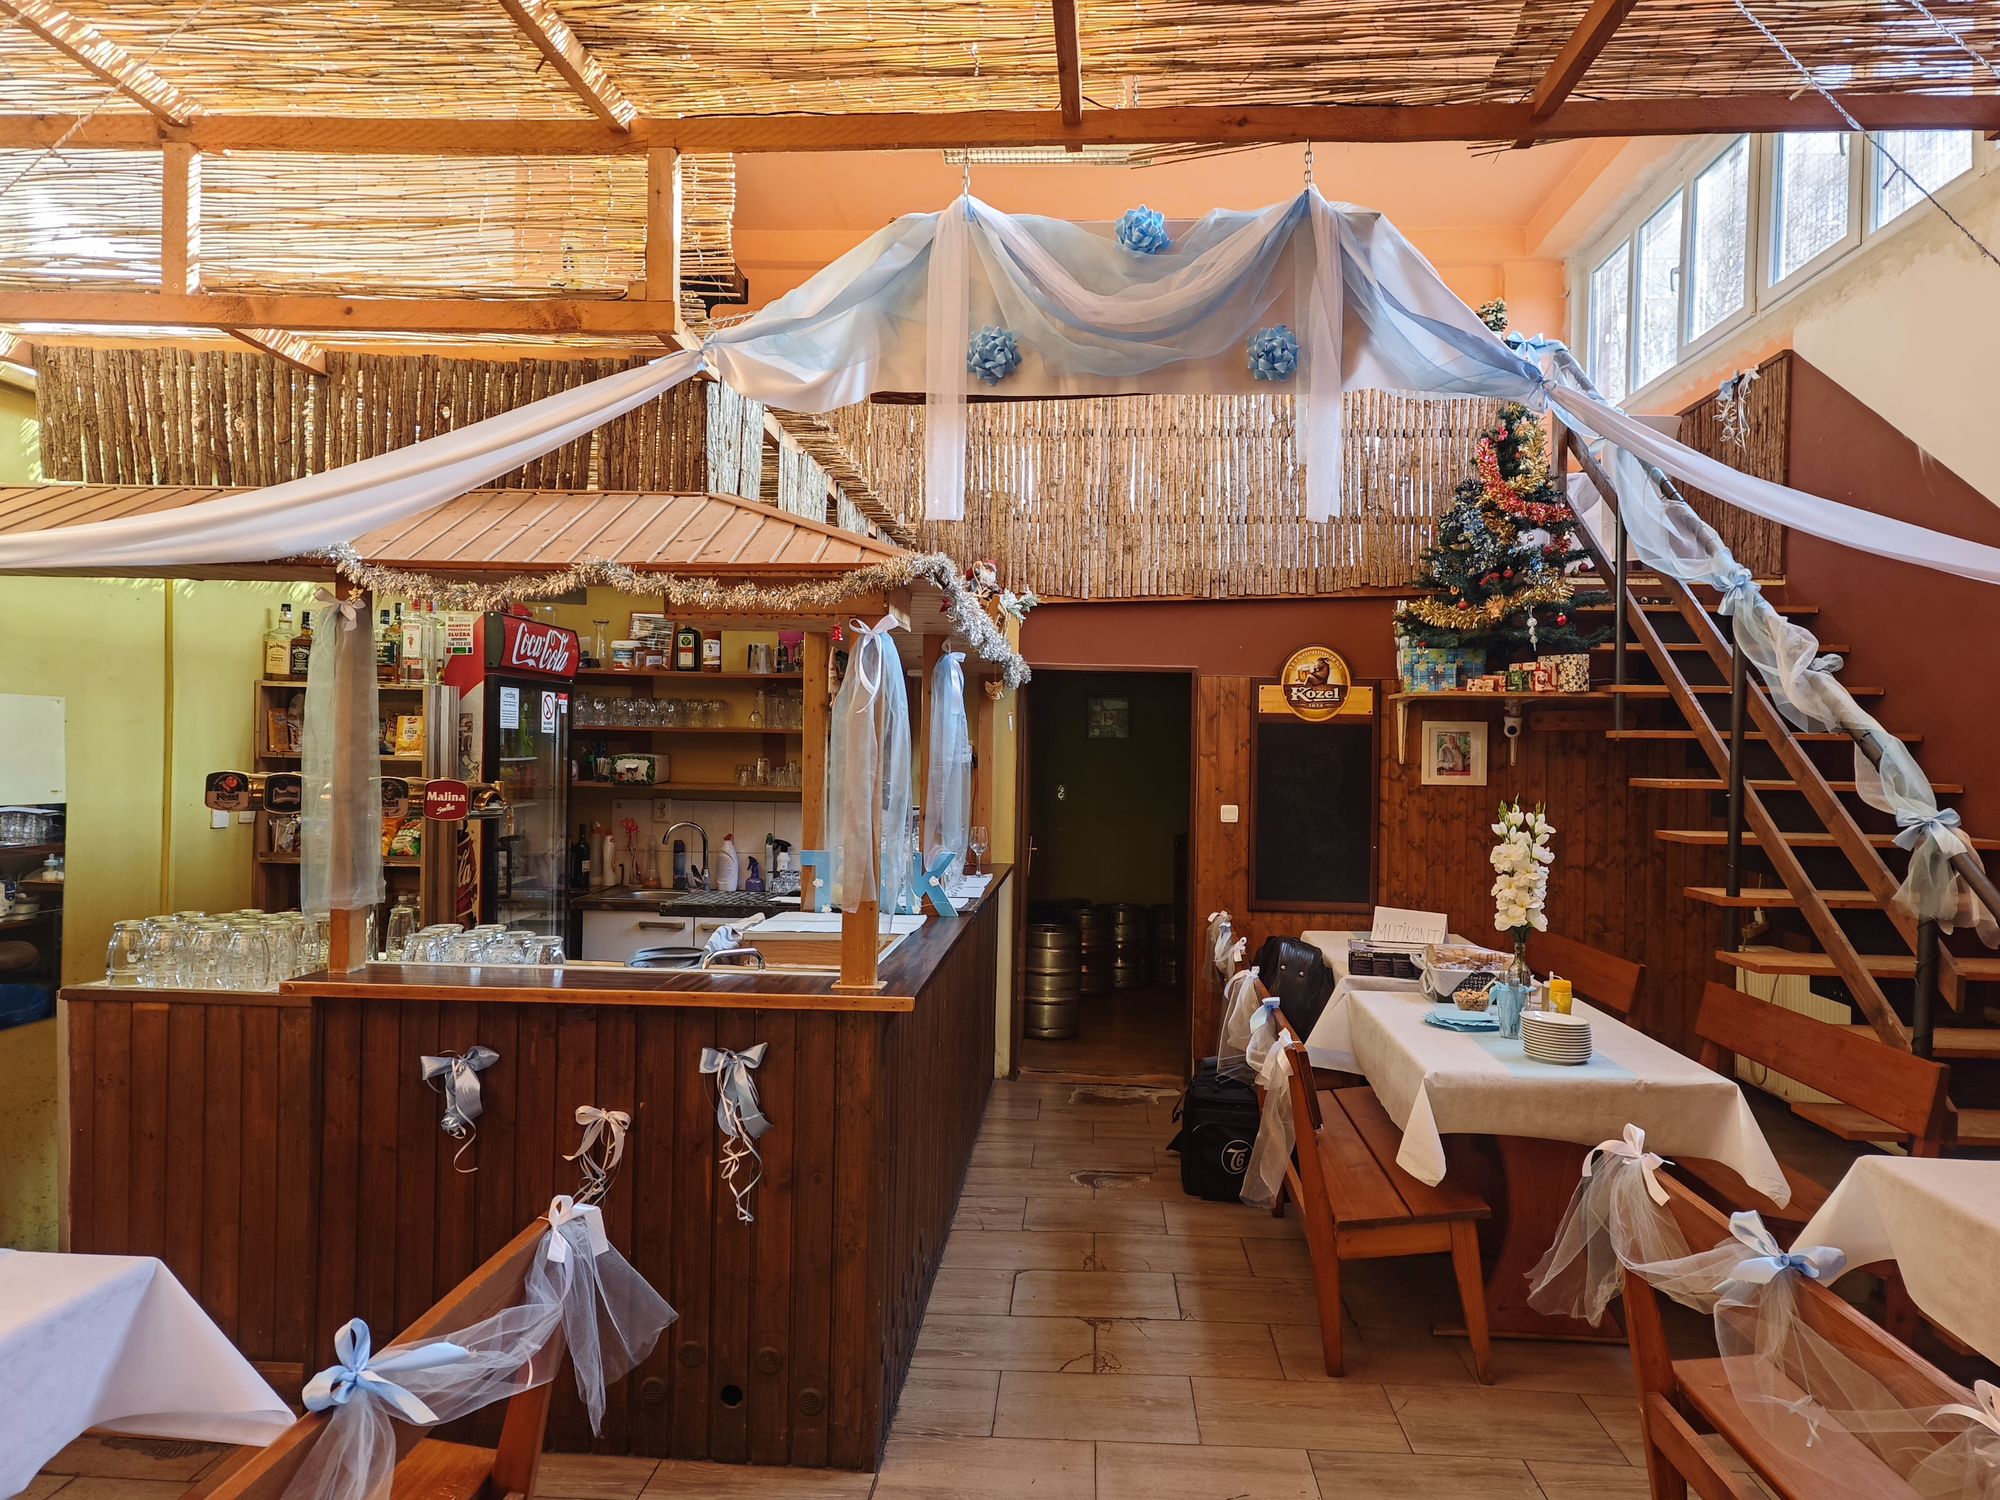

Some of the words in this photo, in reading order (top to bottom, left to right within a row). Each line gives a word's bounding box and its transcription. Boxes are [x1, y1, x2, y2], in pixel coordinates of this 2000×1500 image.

[512, 622, 569, 672] Coca-Cola
[1290, 686, 1340, 702] Kozel
[426, 791, 466, 802] Malina
